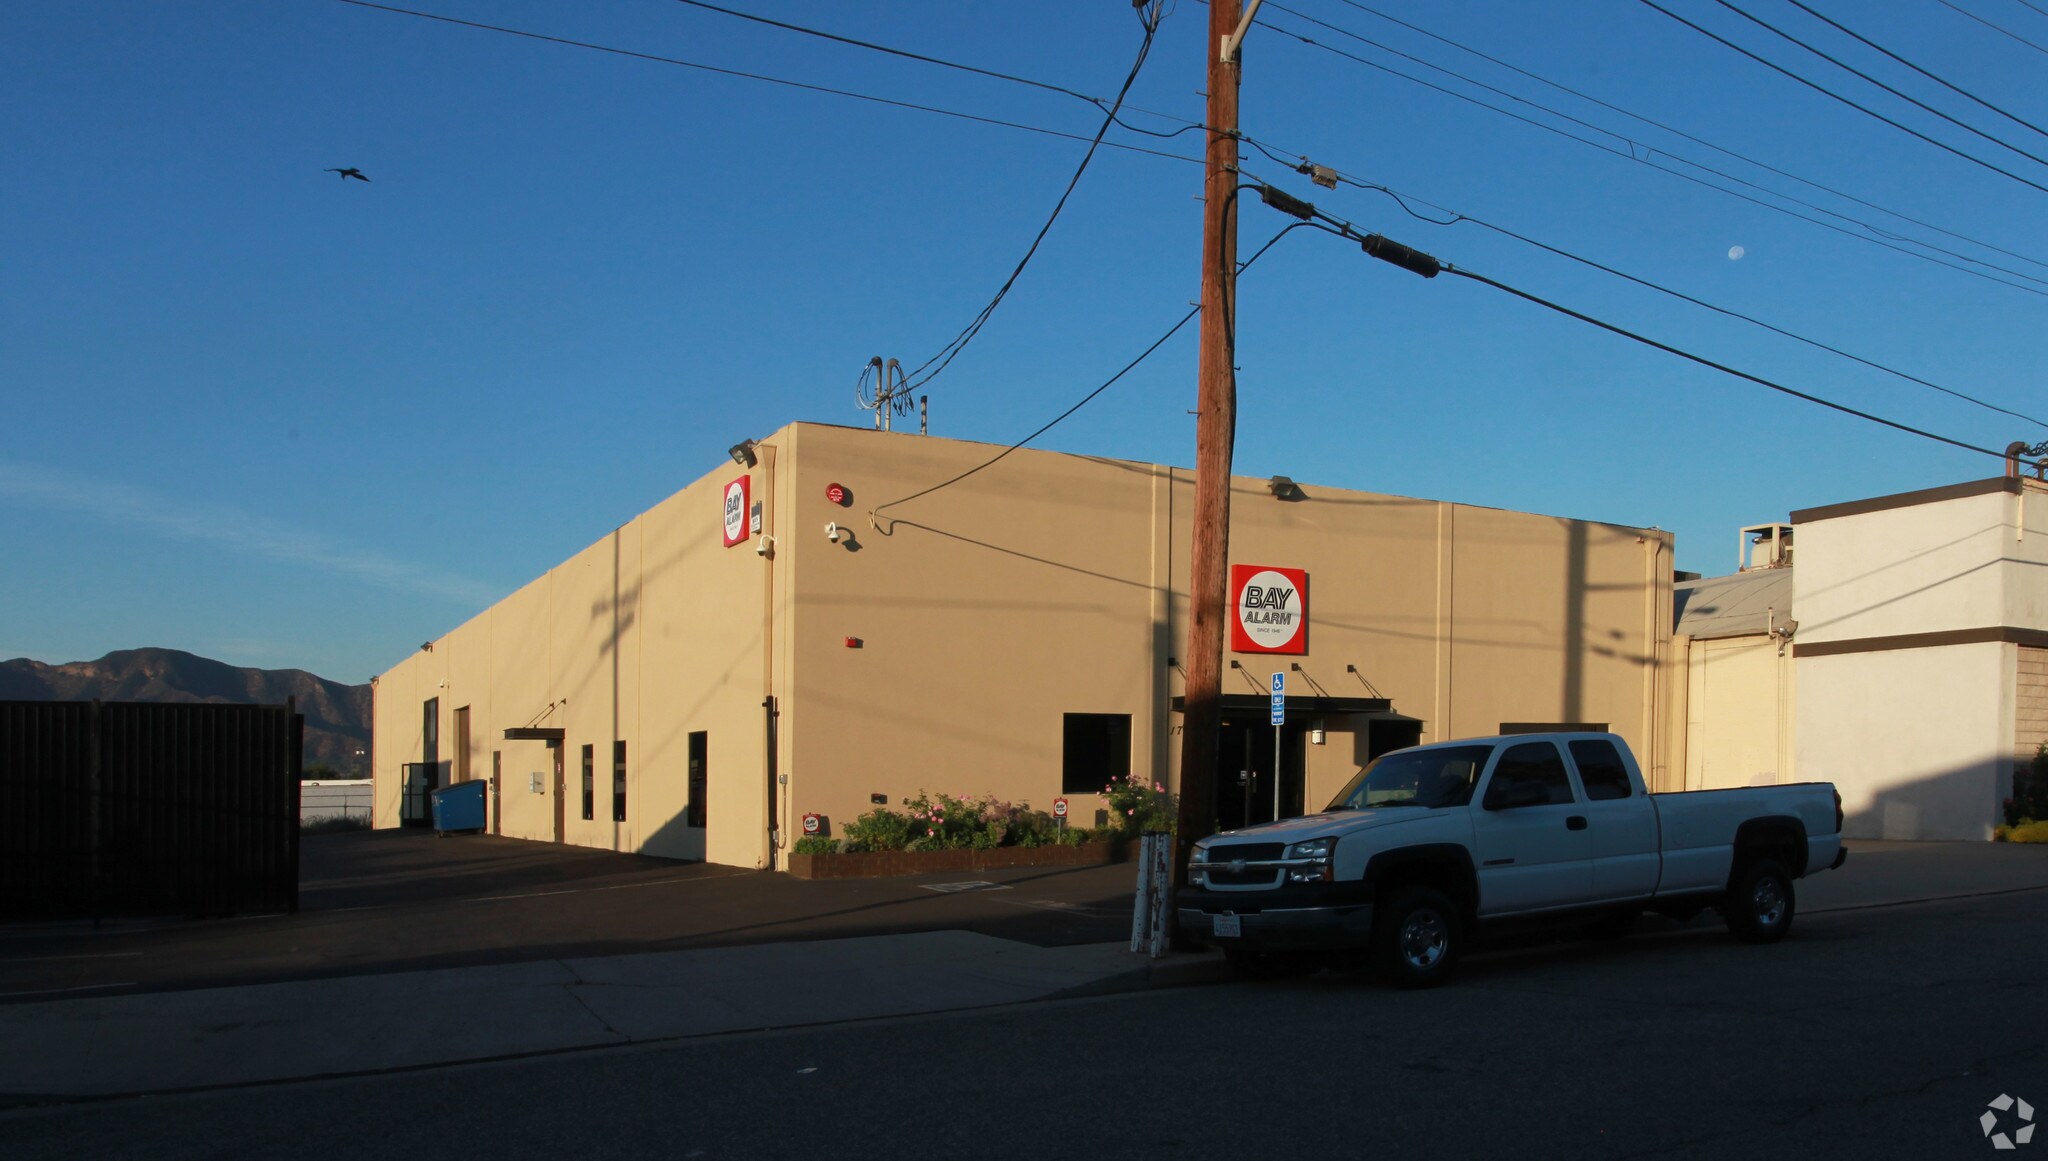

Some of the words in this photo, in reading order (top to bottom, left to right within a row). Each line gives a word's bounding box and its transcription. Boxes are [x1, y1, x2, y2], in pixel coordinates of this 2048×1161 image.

[726, 492, 742, 515] BAY
[726, 511, 741, 526] ALARM
[1245, 586, 1294, 610] BAY
[1244, 611, 1292, 625] ALARM
